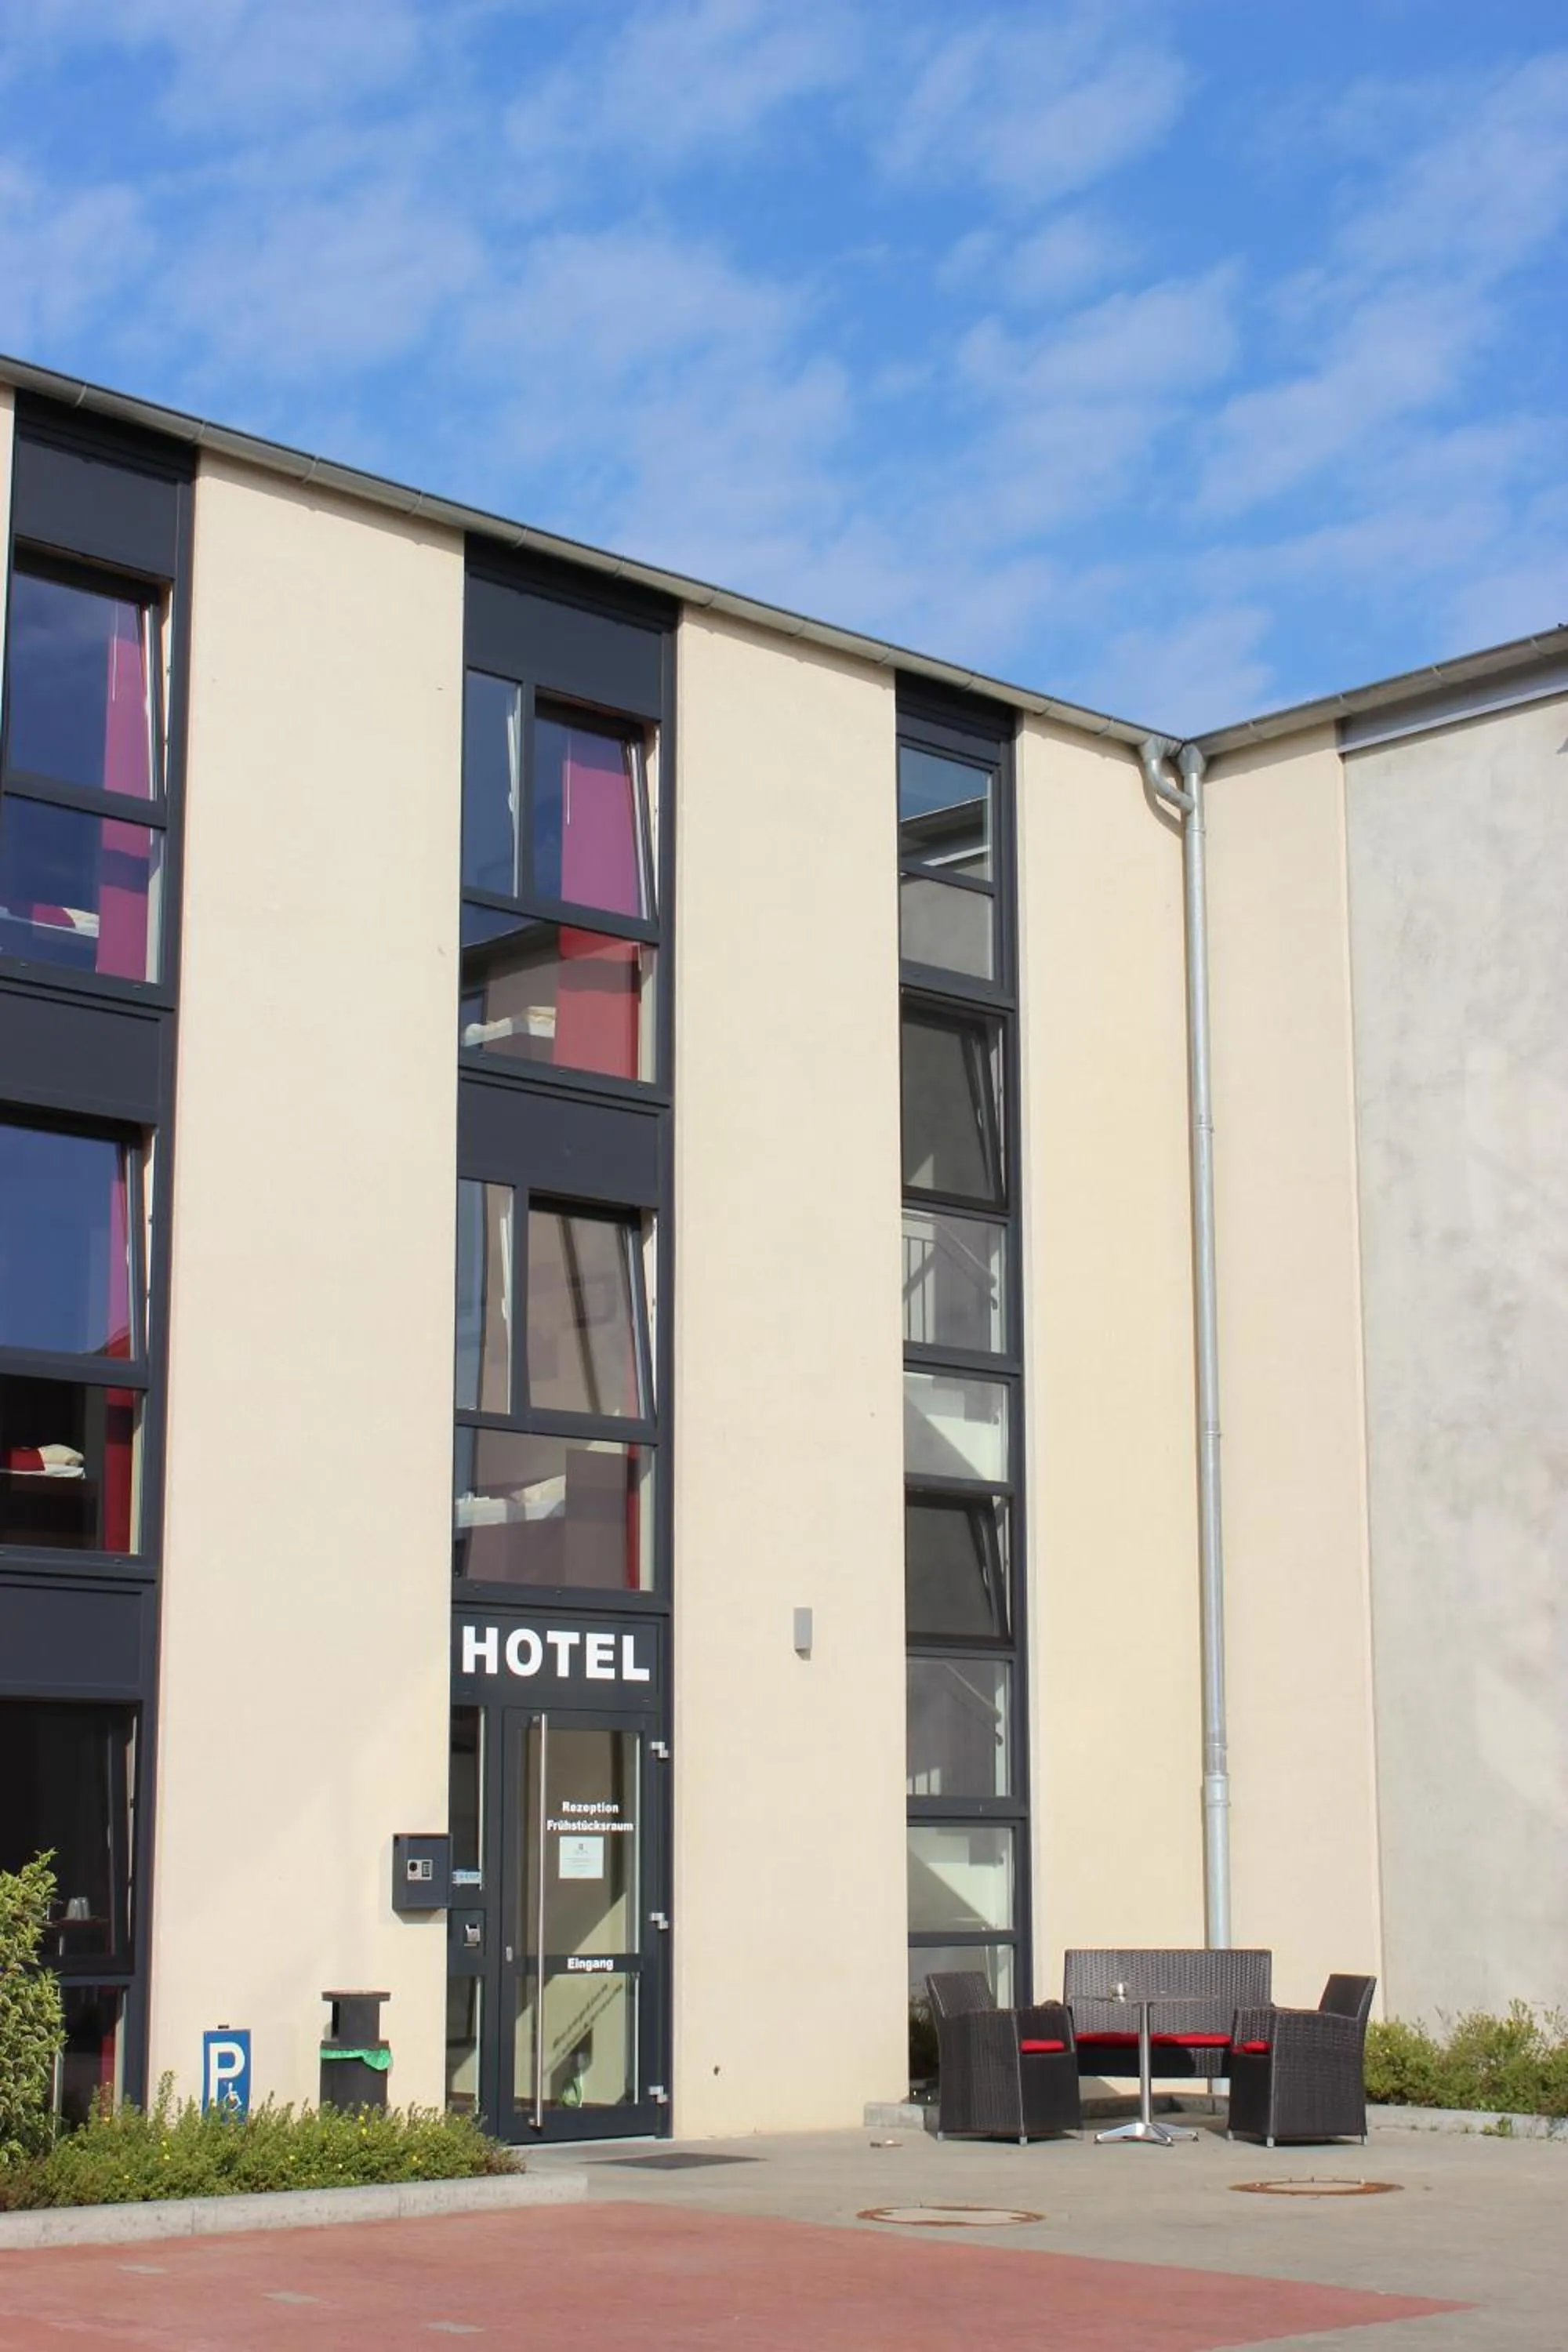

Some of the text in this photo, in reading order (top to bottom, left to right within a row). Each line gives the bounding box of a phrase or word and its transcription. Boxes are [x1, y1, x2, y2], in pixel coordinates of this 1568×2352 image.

[461, 1625, 650, 1681] HOTEL
[562, 1801, 619, 1815] Rezeption
[546, 1819, 634, 1831] Frühstücksraum
[567, 1957, 614, 1971] Eingang
[209, 2042, 245, 2107] P
